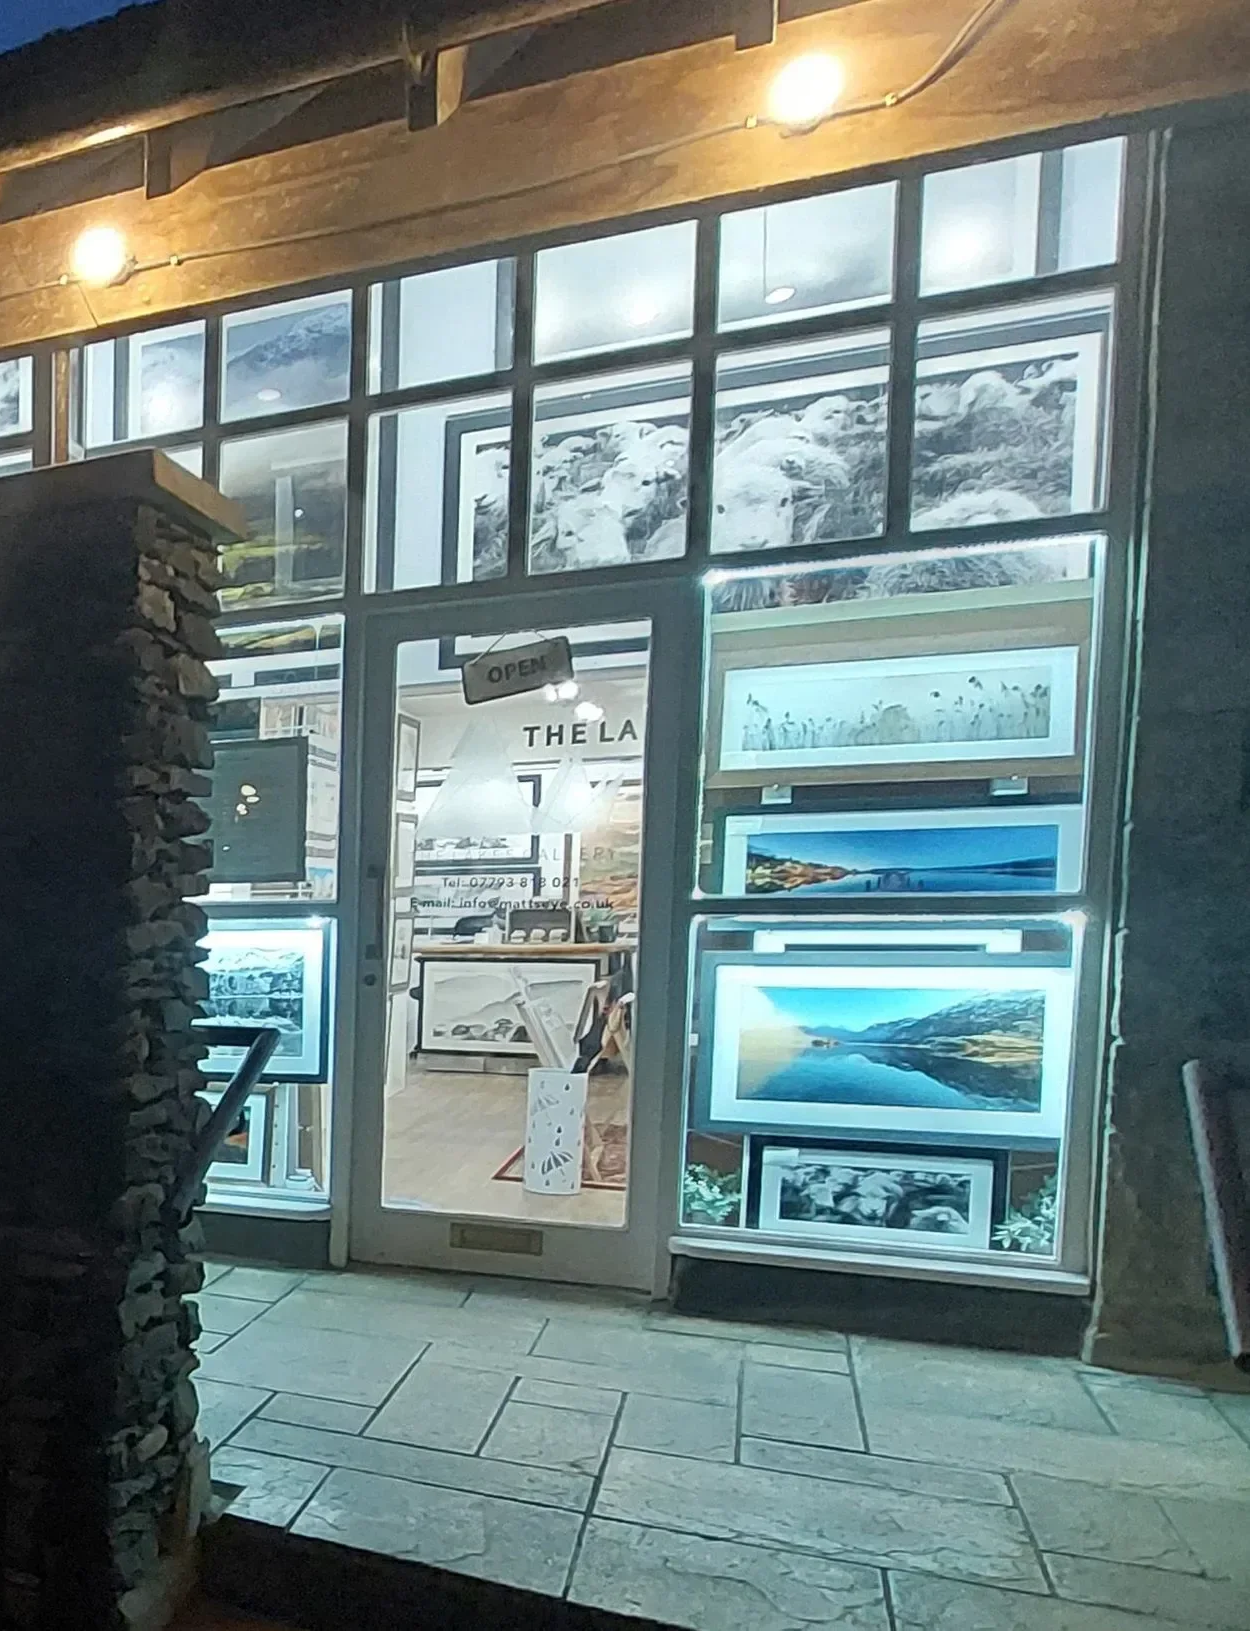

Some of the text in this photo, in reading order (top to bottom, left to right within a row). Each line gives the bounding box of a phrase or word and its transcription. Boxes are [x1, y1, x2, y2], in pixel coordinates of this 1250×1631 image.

[488, 655, 547, 684] OPEN
[522, 719, 638, 747] THE LA
[469, 877, 515, 888] 07793
[551, 877, 579, 888] 021
